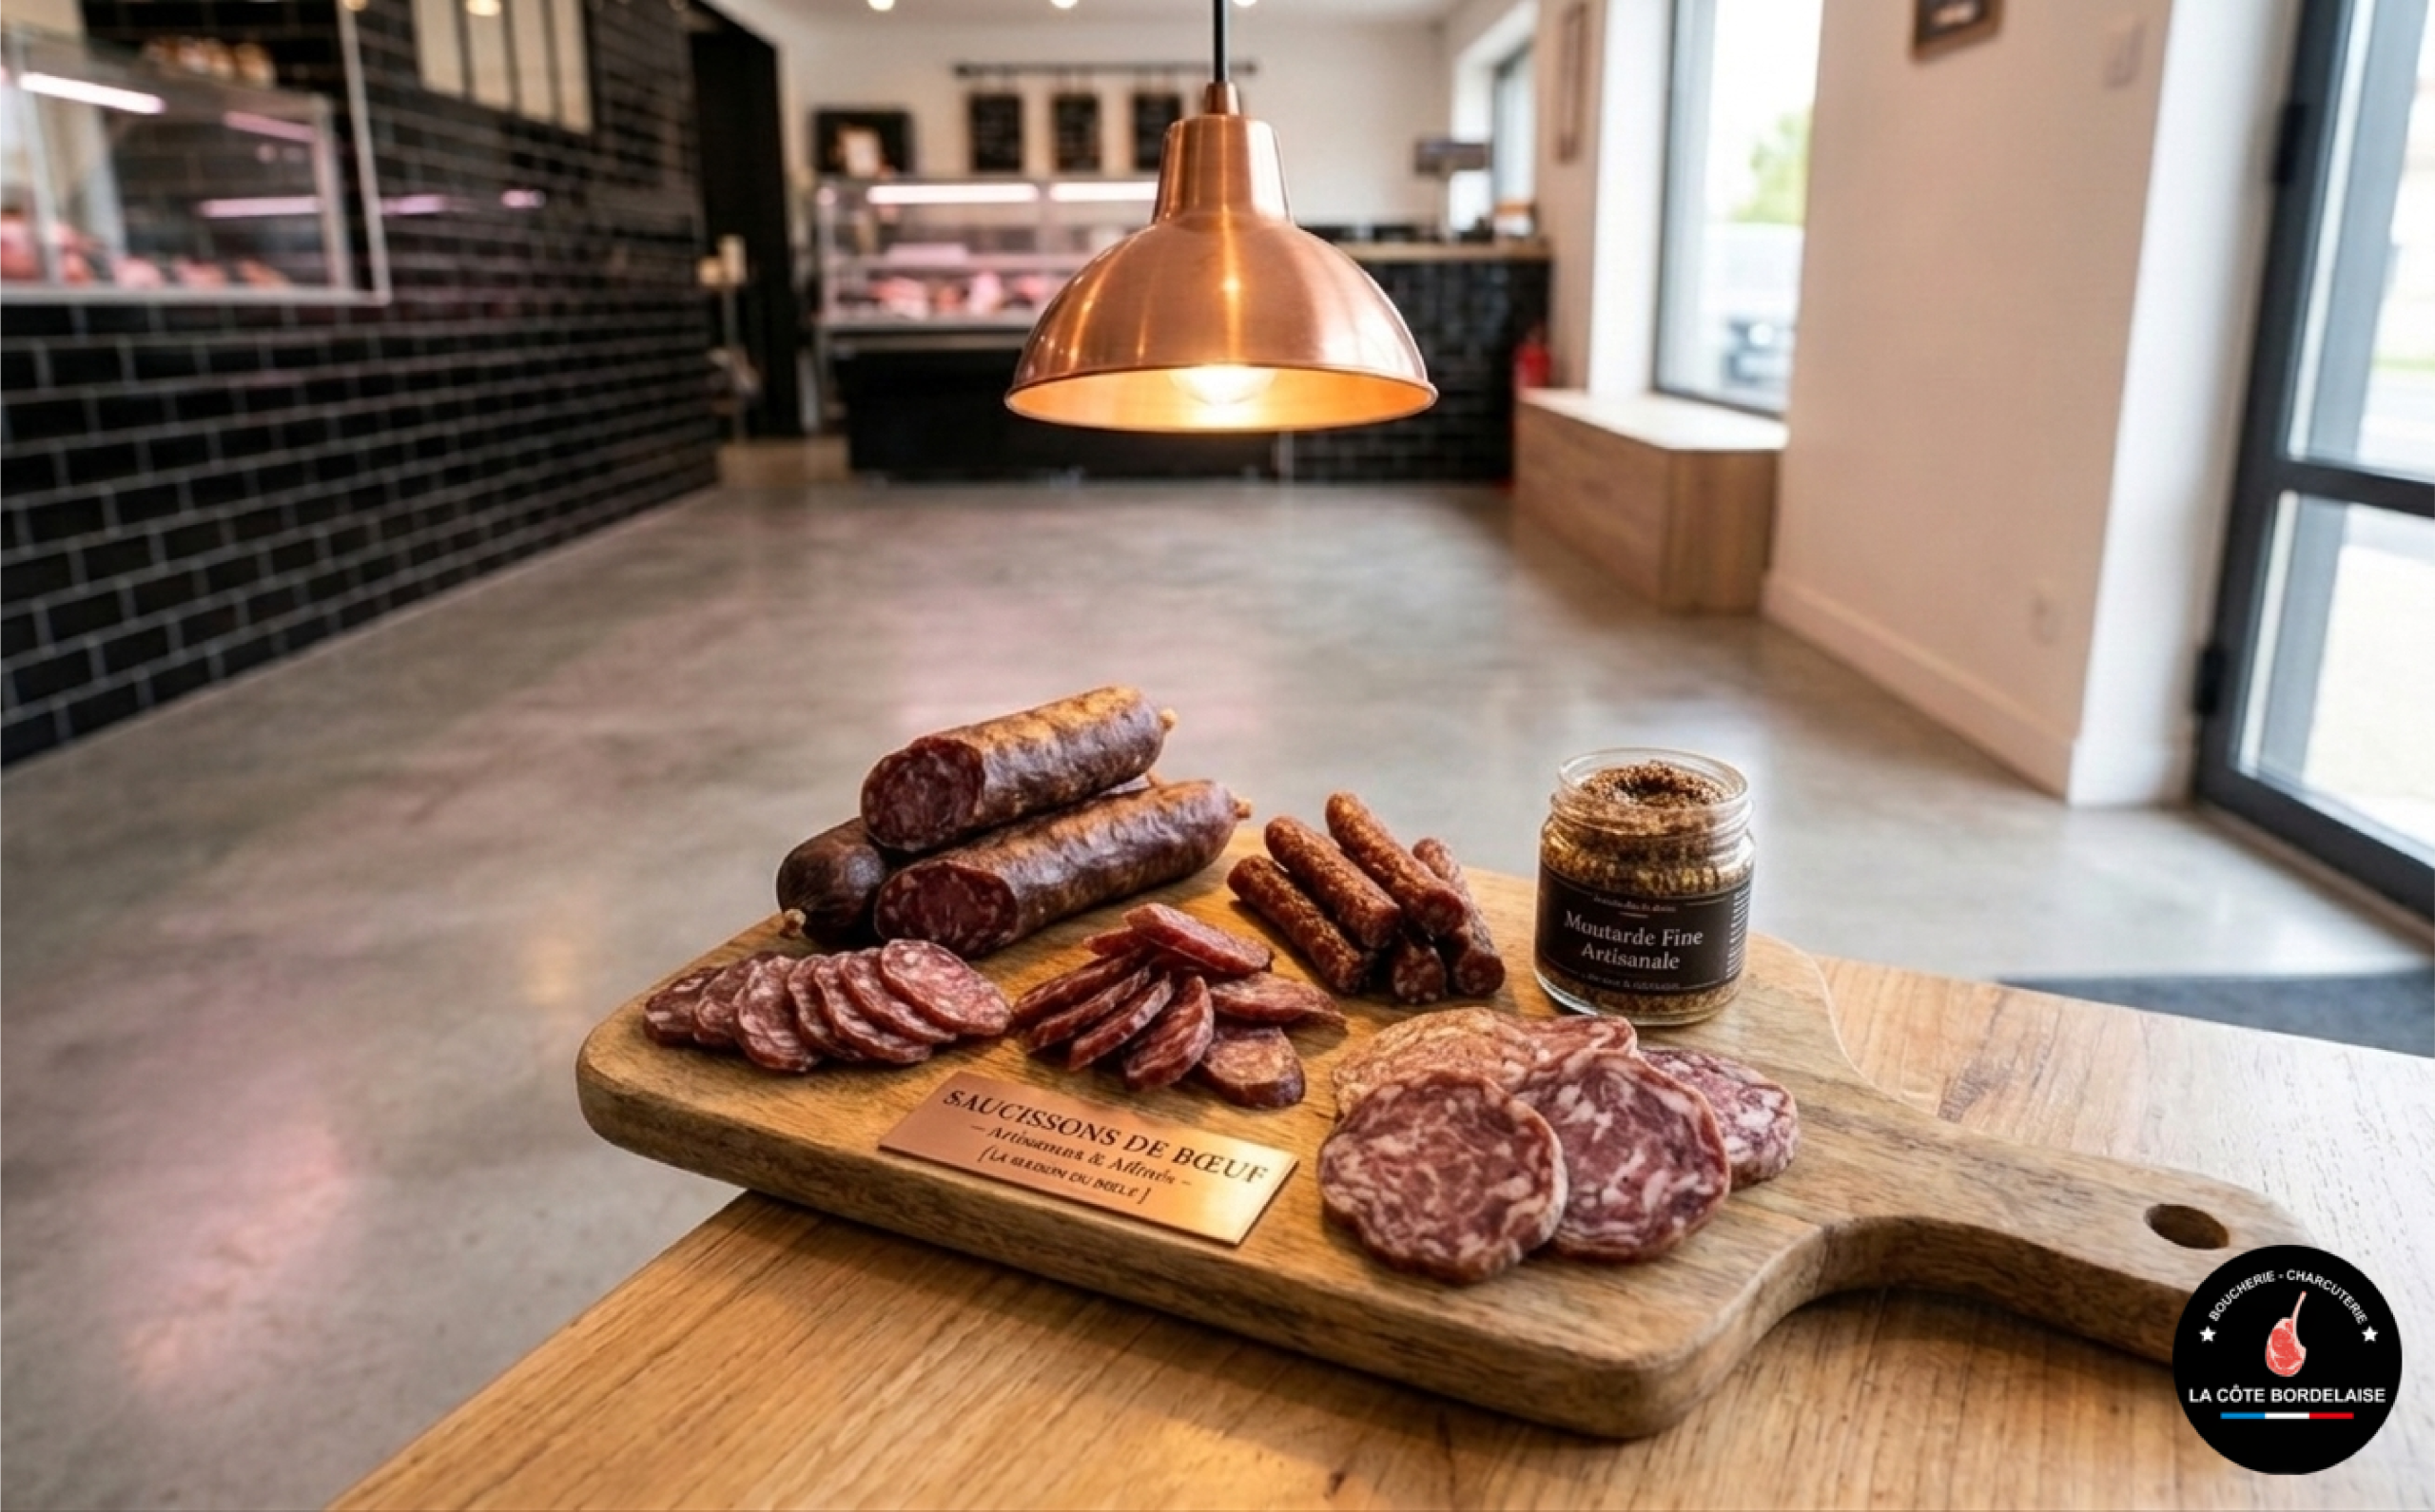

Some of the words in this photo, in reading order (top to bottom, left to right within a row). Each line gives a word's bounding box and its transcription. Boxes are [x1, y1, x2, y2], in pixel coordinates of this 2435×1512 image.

[1564, 910, 1656, 946] Moutarde
[1661, 928, 1704, 947] Fine
[1581, 942, 1681, 970] Artisanale
[943, 1090, 1121, 1146] SAUCISSONS
[1122, 1134, 1170, 1159] DE
[1171, 1146, 1269, 1183] BŒUF
